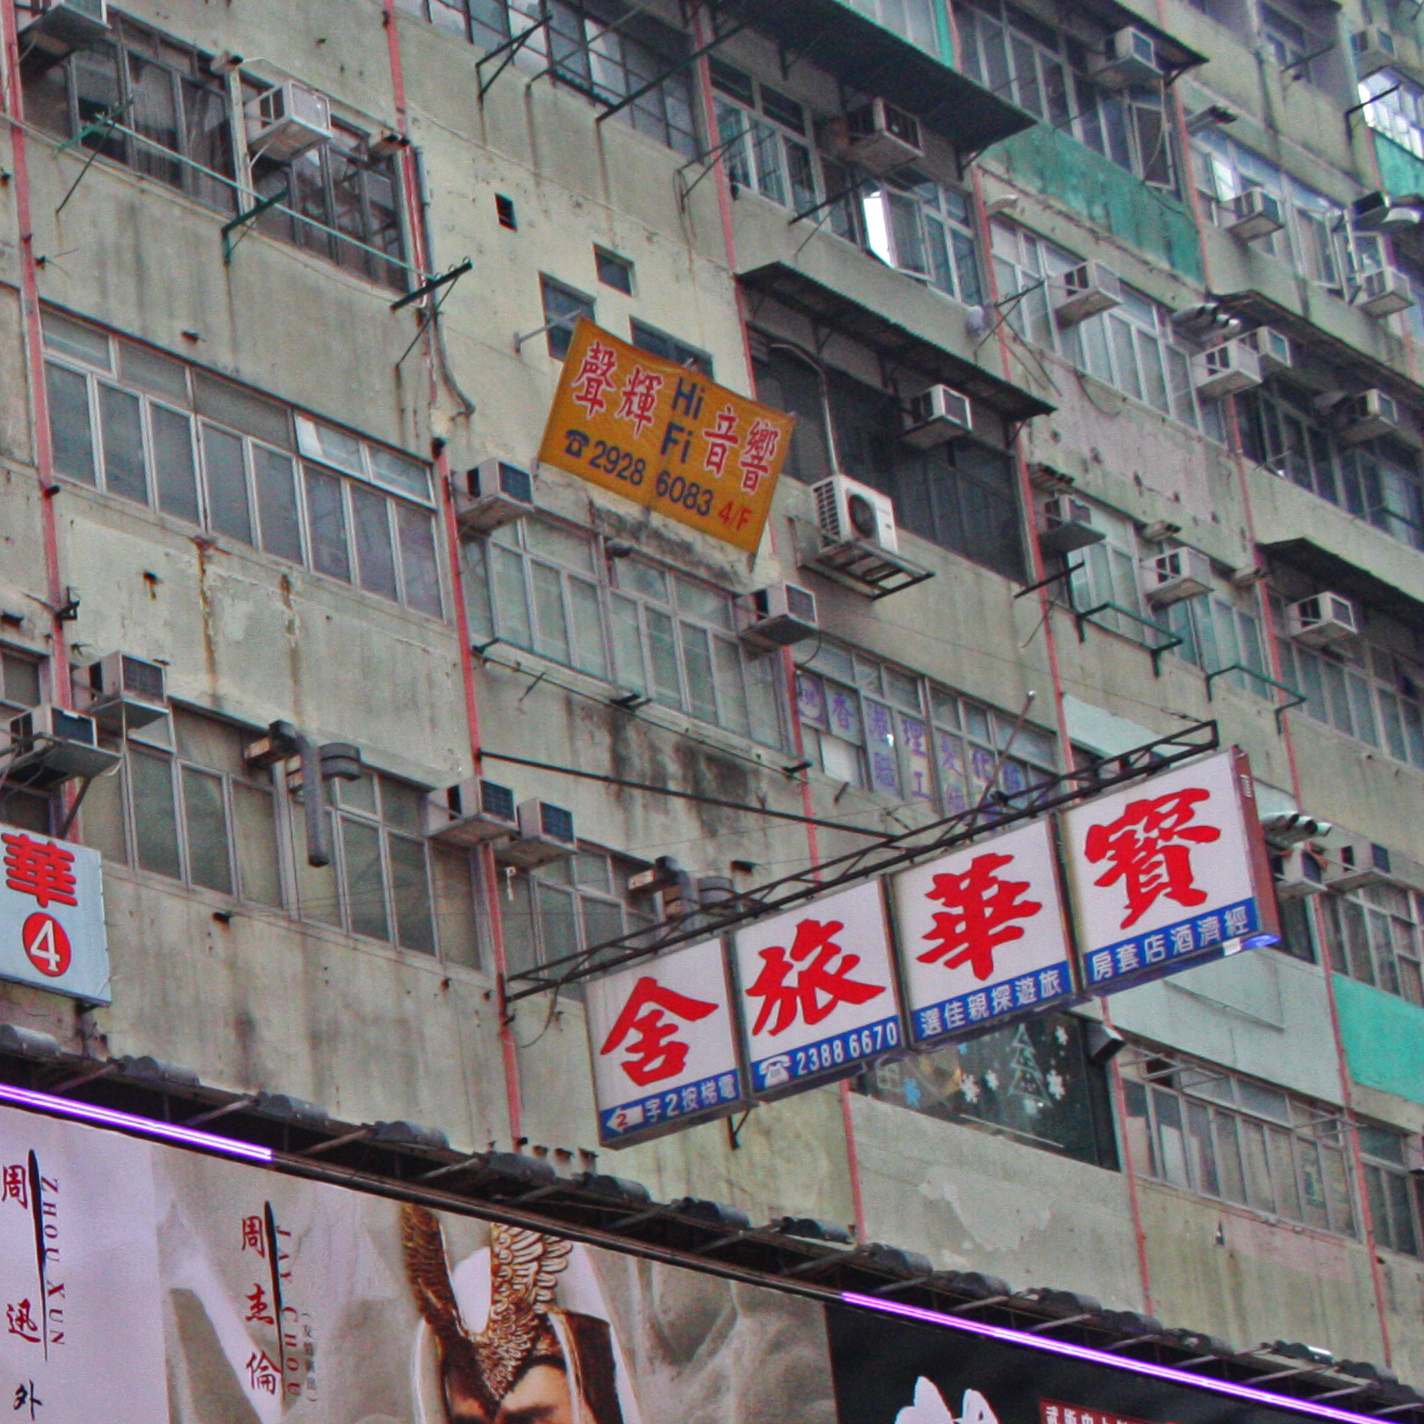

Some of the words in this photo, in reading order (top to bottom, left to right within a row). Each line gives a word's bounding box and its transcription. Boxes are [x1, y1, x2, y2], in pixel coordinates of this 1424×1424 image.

[570, 341, 665, 437] 聲輝
[671, 376, 707, 420] Hi
[589, 440, 646, 486] 2928
[655, 470, 715, 516] 6083
[718, 501, 753, 532] 4/F
[659, 422, 694, 464] Fi
[704, 405, 780, 494] 音響
[795, 1040, 845, 1076] 2388
[850, 1022, 899, 1062] 6670
[2, 1164, 41, 1344] 周迅
